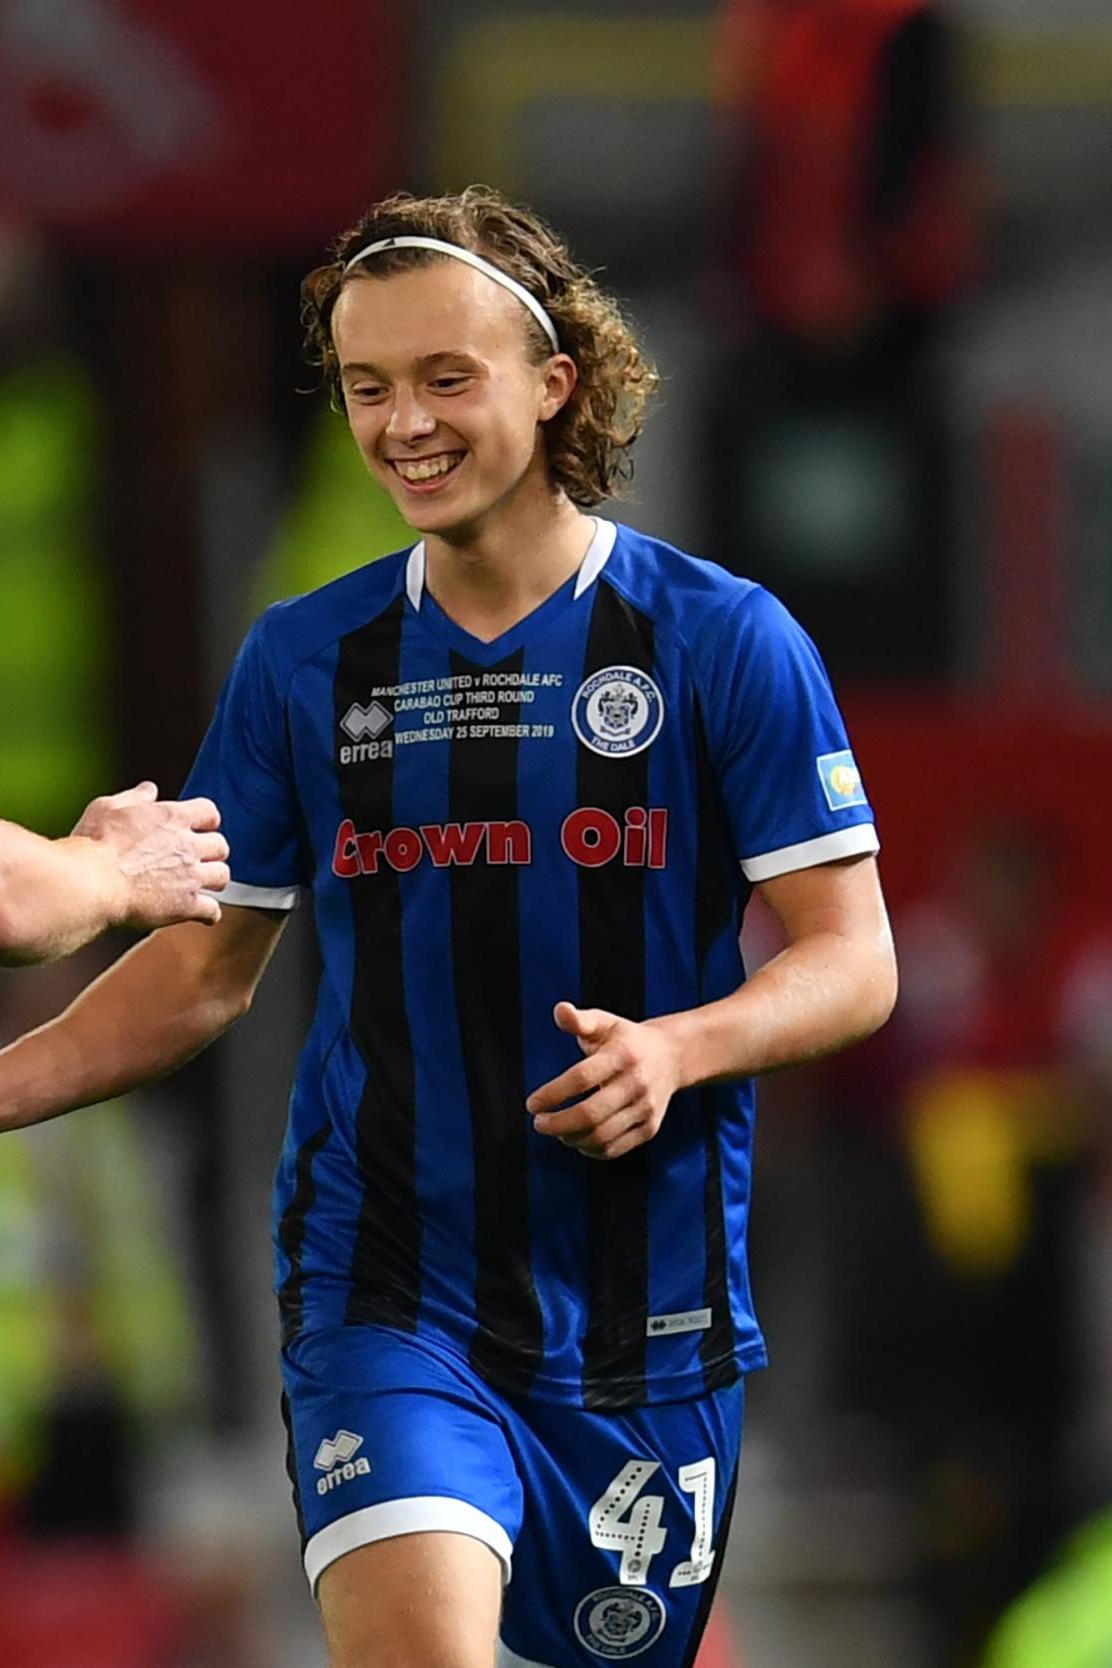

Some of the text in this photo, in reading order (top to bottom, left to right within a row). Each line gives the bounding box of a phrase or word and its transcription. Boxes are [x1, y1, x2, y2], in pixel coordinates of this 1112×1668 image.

[370, 679, 435, 697] MANCHESTER
[436, 675, 472, 691] UNITED
[482, 673, 540, 687] ROCHDALE
[541, 673, 563, 687] AFC
[582, 671, 633, 699] ROCHDALE
[394, 690, 535, 712] CARABAO CUP THIRD ROUND
[423, 706, 500, 725] OLD TRAFFORD
[395, 724, 555, 745] WEDNESDAY 25 SEPTEMBER 2019
[591, 736, 636, 752] THE DALE
[340, 740, 393, 764] errea
[332, 806, 668, 878] Crown Oil
[590, 1456, 716, 1588] 41
